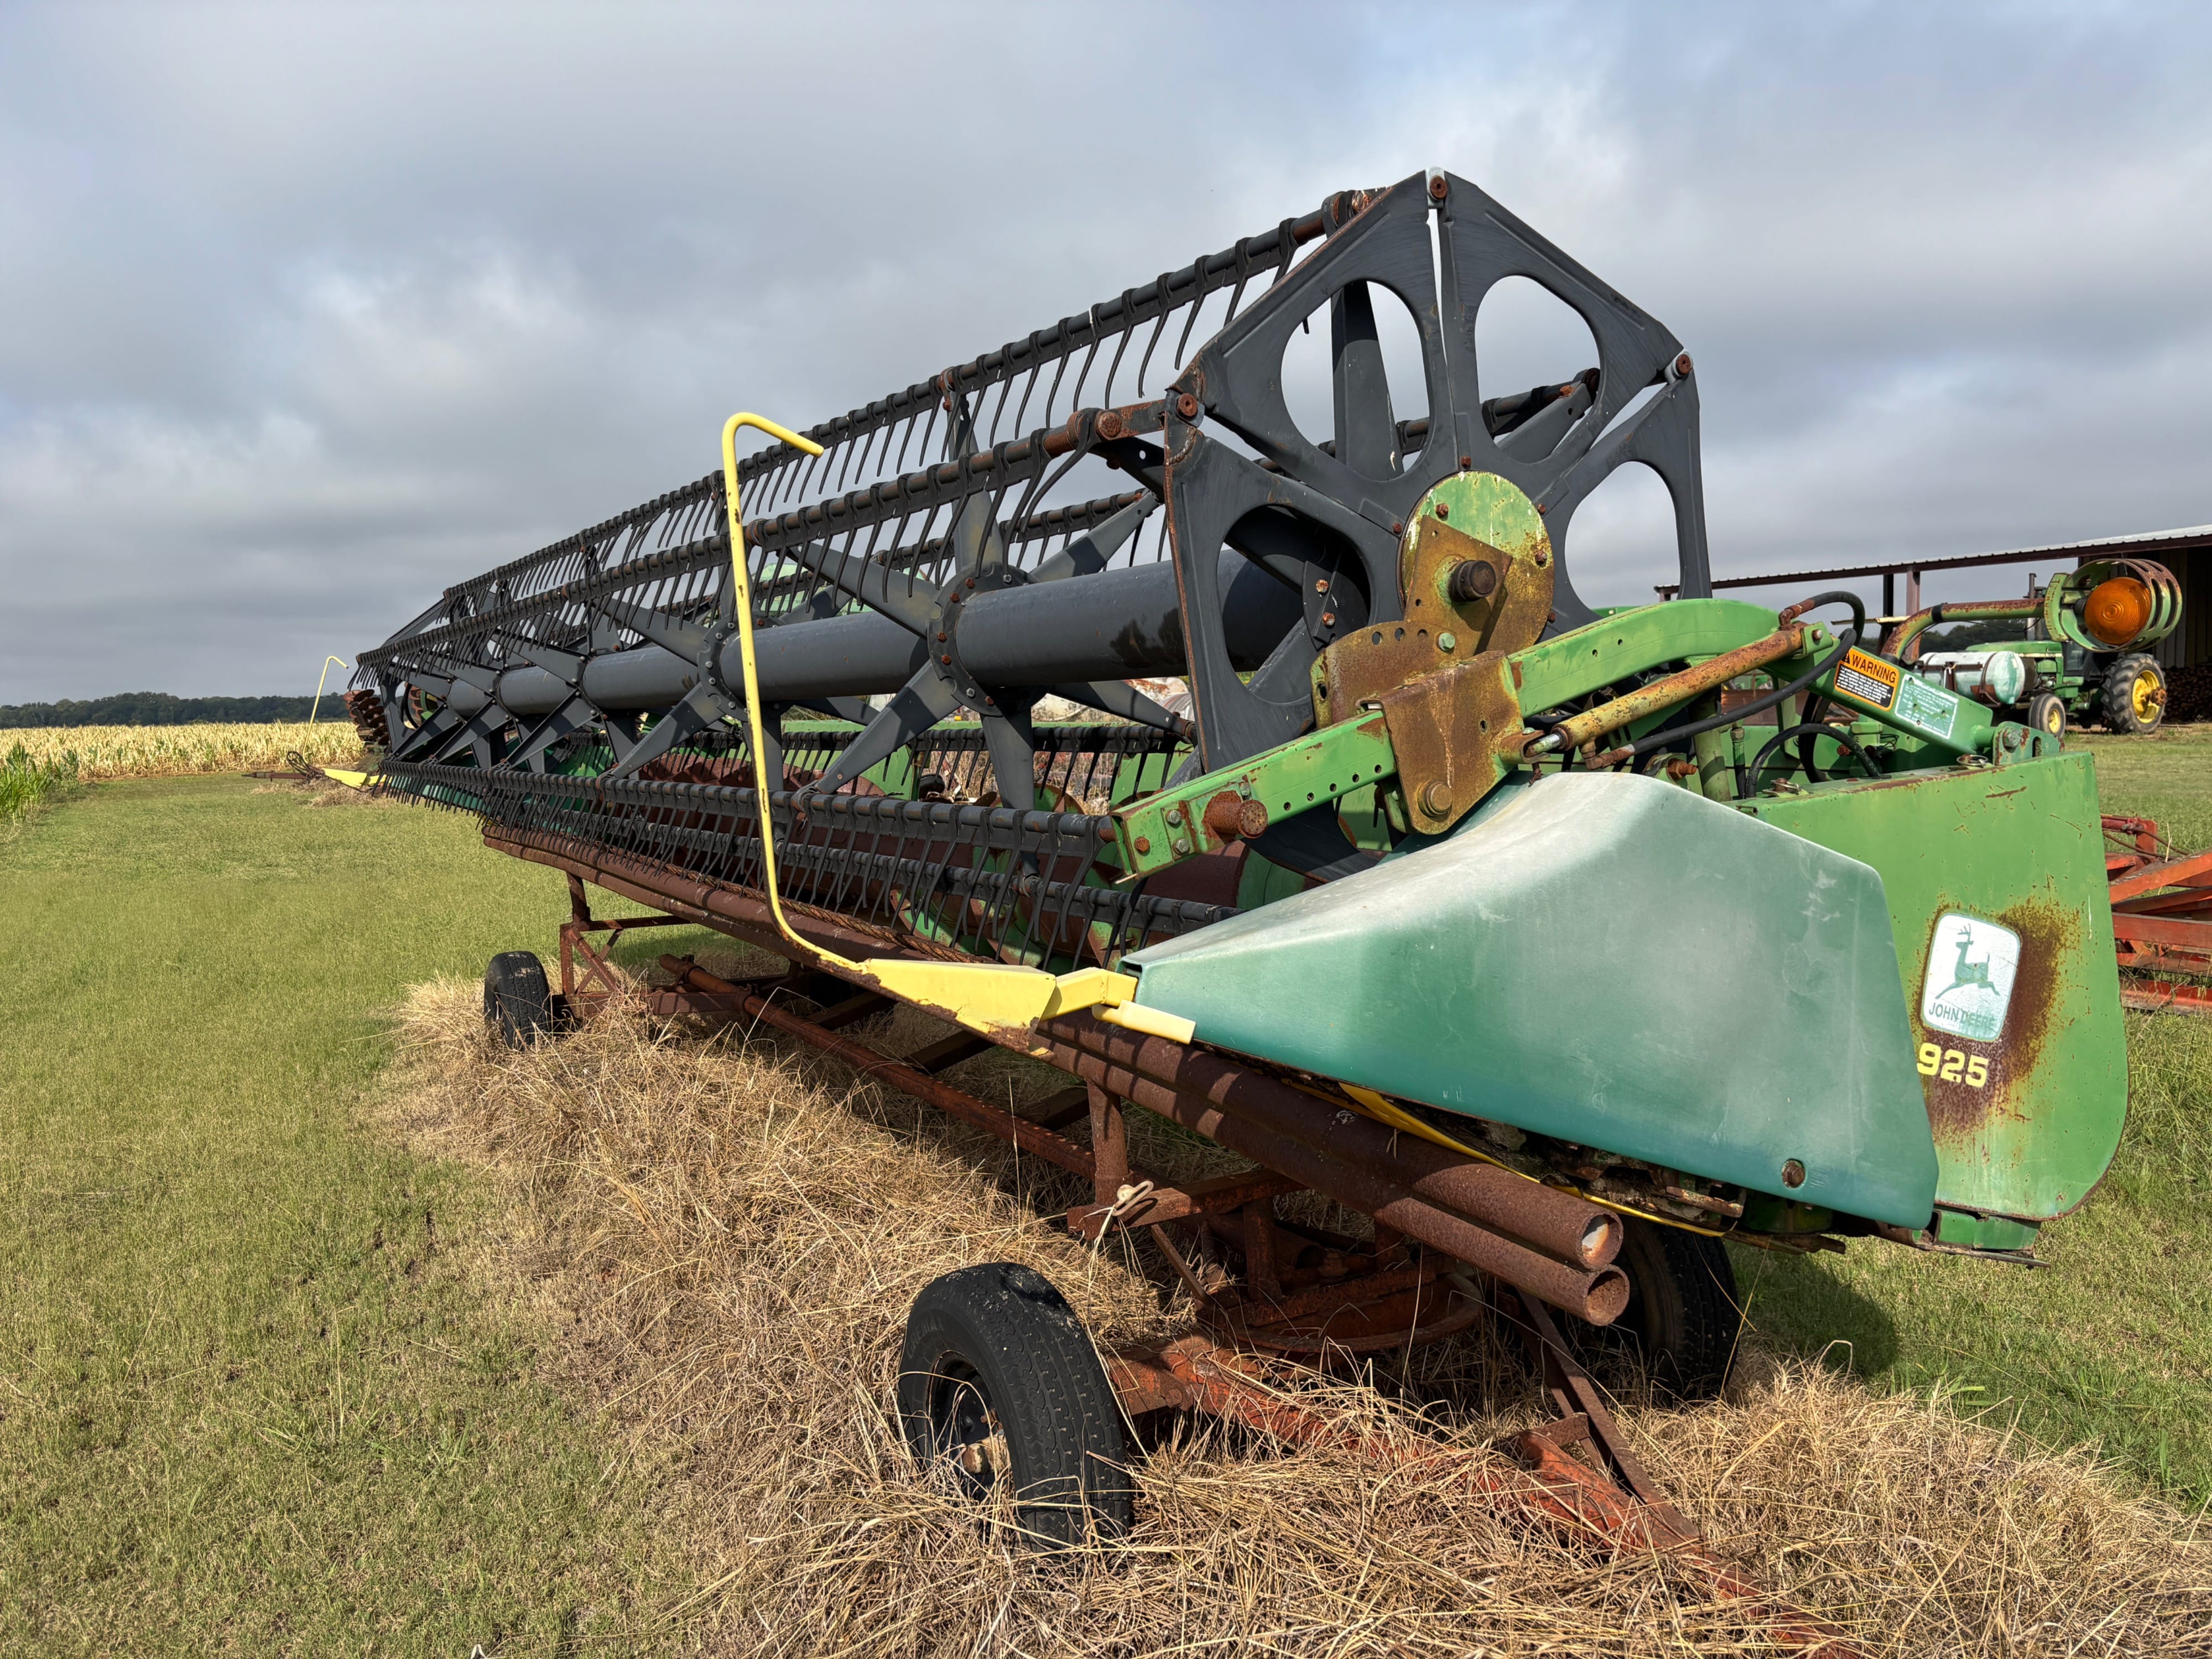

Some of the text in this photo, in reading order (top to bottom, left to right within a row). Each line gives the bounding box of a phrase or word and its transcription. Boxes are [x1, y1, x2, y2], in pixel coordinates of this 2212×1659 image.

[1852, 654, 1897, 684] WARNING
[1929, 1003, 1960, 1022] JOHN
[1917, 1042, 1990, 1088] 925
